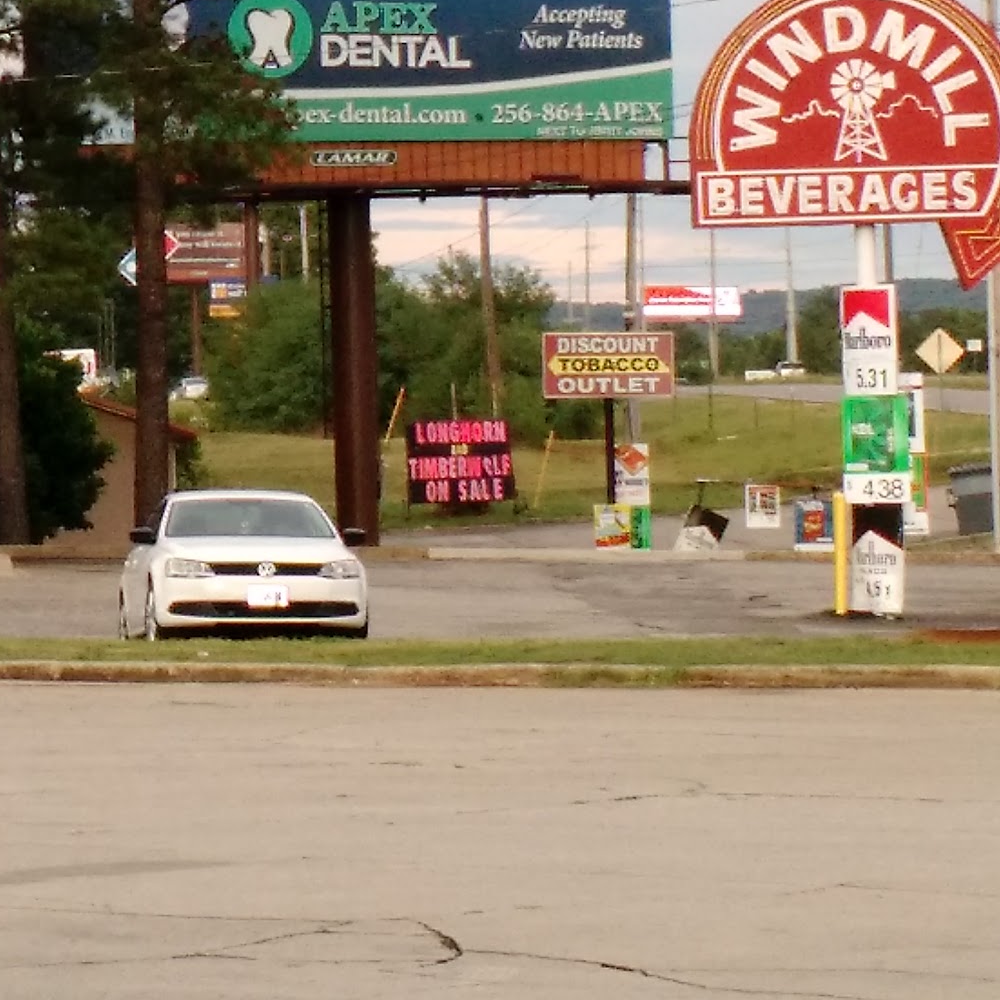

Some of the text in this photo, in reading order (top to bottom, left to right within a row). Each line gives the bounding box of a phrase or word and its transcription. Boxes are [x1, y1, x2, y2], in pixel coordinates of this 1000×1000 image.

[320, 1, 438, 34] APEX
[532, 4, 626, 28] Accepting
[519, 29, 643, 48] New Patients
[320, 34, 471, 67] DENTAL
[730, 6, 989, 152] WINDMILL
[491, 102, 663, 123] 256-864-APEX
[316, 153, 390, 164] LAMAR
[708, 171, 978, 215] BEVERAGES
[557, 337, 659, 353] DISCOUNT
[558, 358, 659, 371] TOBACCO
[557, 377, 660, 393] OUTLET
[856, 368, 887, 388] 5.31
[415, 421, 506, 443] LONGHORN
[425, 478, 504, 502] ON SALE
